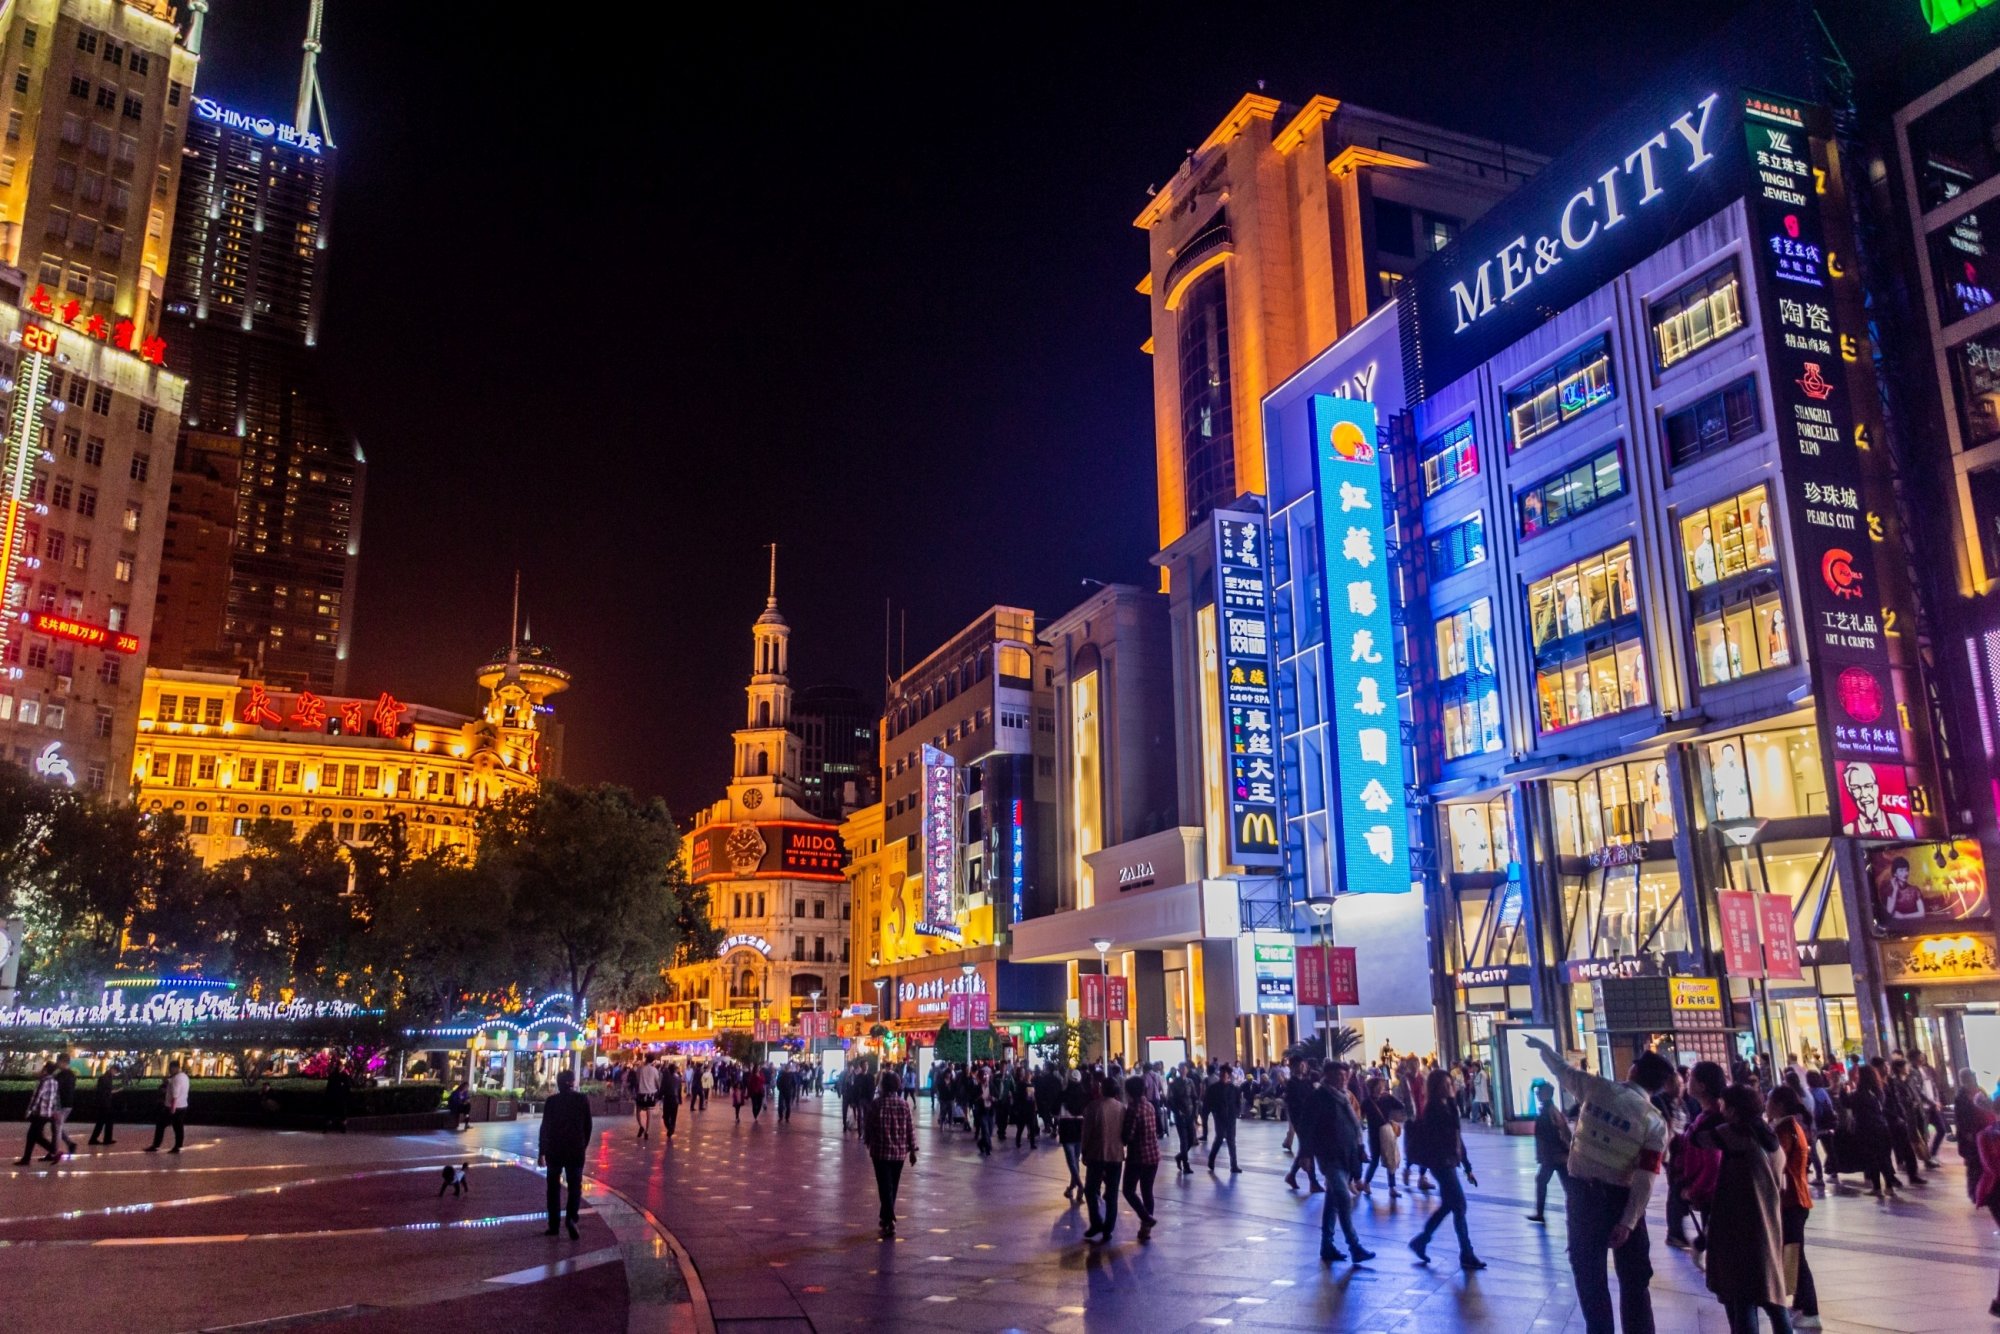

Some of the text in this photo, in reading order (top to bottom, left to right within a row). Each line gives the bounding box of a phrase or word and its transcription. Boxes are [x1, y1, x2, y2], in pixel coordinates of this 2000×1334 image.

[1757, 150, 1809, 176] 英立珠宝
[1760, 170, 1795, 189] YINGLI
[1763, 187, 1807, 206] JEWELRY
[1450, 93, 1718, 334] ME&CITY
[1779, 298, 1832, 334] 陶瓷
[1785, 333, 1832, 355] 精品商场
[1794, 405, 1832, 424] SHANGHAI
[1796, 422, 1840, 442] PORCELAIN
[1799, 440, 1820, 456] EXPO
[1804, 482, 1860, 510] 珍珠城
[35, 504, 49, 516] 20
[1806, 509, 1856, 530] PEARLS CITY
[1822, 611, 1878, 633] 工艺礼品
[1881, 607, 1900, 637] 2
[1825, 633, 1838, 645] ART
[1848, 636, 1875, 649] CRAFTS
[1253, 695, 1270, 704] SPA
[1838, 741, 1851, 750] New
[1853, 742, 1871, 752] World
[1882, 794, 1907, 808] KFC
[793, 834, 835, 850] MIDO
[1119, 861, 1154, 883] ZARA
[274, 997, 313, 1022] Coffee
